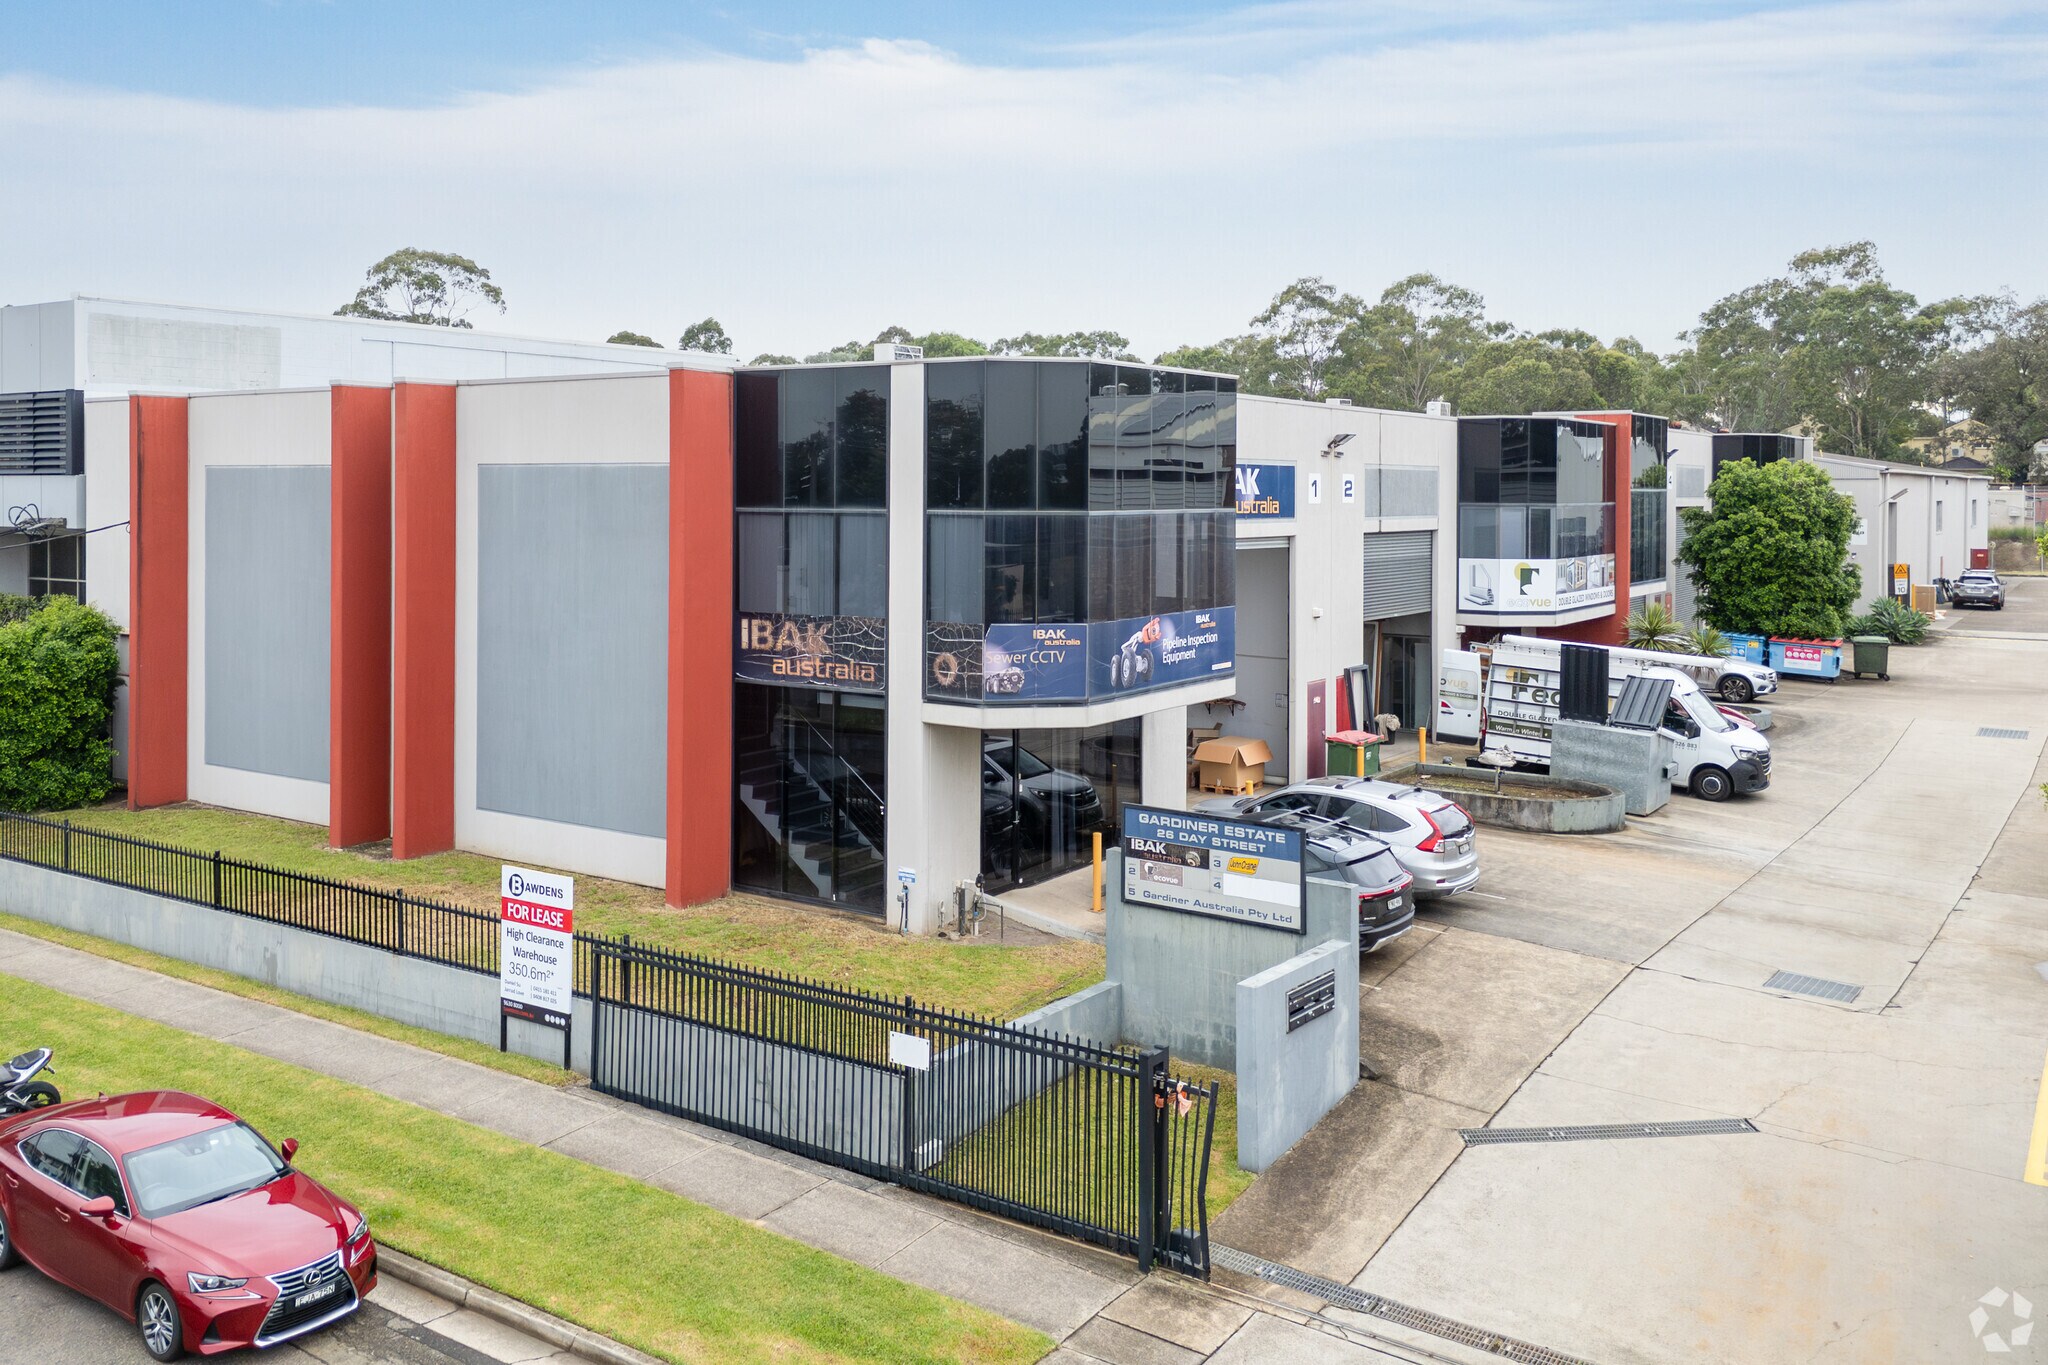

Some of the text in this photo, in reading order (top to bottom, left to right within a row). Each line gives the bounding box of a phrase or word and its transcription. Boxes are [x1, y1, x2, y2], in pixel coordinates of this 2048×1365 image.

[1236, 468, 1260, 495] AK
[1311, 479, 1318, 497] 1
[1344, 480, 1353, 497] 2
[1236, 496, 1279, 514] ustralia
[1195, 614, 1210, 624] IBAK
[741, 618, 833, 655] IBAK
[1032, 629, 1066, 640] IBAK
[1162, 632, 1218, 652] Pipeline Inspection
[986, 650, 1066, 664] Sewer CCTV
[1162, 648, 1196, 665] Equipment
[772, 657, 875, 682] australia
[1495, 724, 1513, 732] Warm
[1138, 813, 1286, 844] GARDINER ESTATE
[1131, 838, 1167, 854] IBAK
[1156, 829, 1266, 854] 26 DAY STREET
[1128, 867, 1136, 875] 2
[1153, 874, 1179, 884] ecovue
[509, 873, 563, 899] BAWDENS
[1213, 881, 1221, 889] 4
[507, 902, 564, 929] FOR LEASE
[1143, 890, 1189, 906] Gardiner
[1193, 899, 1244, 915] Australia
[1248, 908, 1268, 920] Pty
[1272, 912, 1292, 923] Ltd
[506, 927, 564, 949] High Clearance
[513, 945, 557, 966] Warehouse
